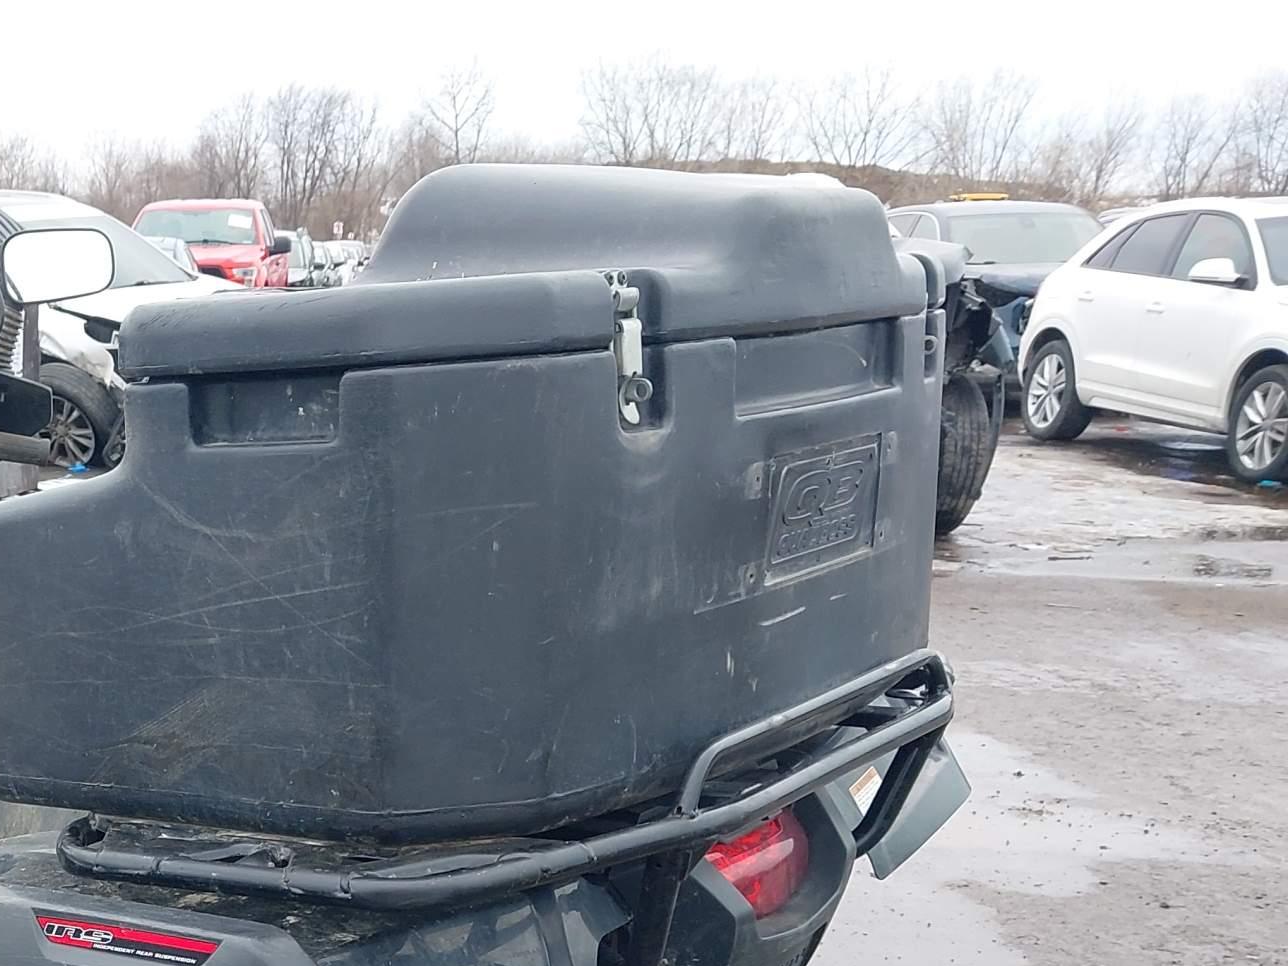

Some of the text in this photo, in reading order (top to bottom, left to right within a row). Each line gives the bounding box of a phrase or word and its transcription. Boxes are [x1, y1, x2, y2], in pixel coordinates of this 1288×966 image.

[44, 922, 113, 944] IRS
[92, 943, 197, 964] INDEPENDENT REAR SUSPENSION
